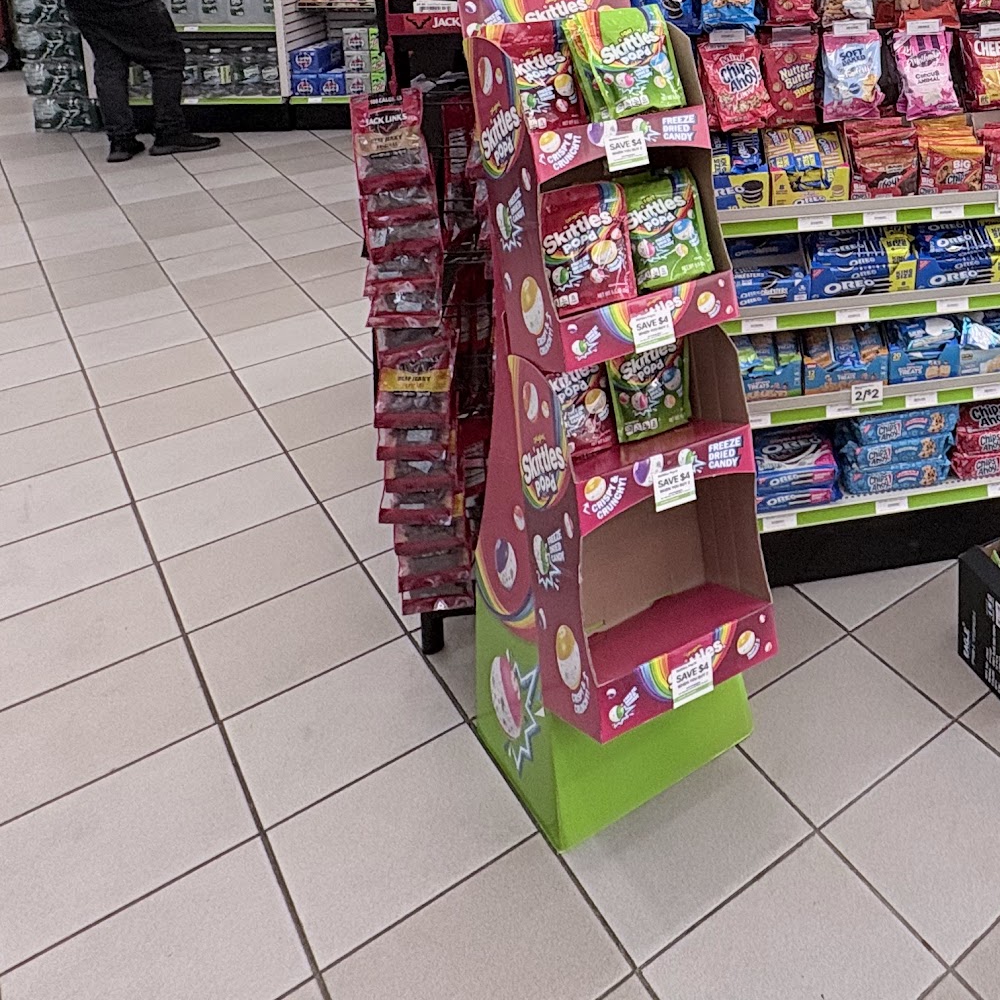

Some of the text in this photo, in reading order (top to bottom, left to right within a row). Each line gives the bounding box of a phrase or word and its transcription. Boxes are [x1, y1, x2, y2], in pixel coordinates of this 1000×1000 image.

[432, 16, 461, 28] JACK
[601, 30, 660, 65] Skittles
[839, 49, 866, 60] SOFT
[721, 53, 744, 64] Mini
[720, 61, 755, 82] Chips
[778, 62, 812, 78] Nutter
[784, 70, 815, 85] Butter
[662, 114, 695, 125] FREEZE
[480, 105, 523, 161] Skittles
[662, 123, 690, 134] DRIED
[662, 131, 694, 142] CANDY
[547, 137, 570, 165] CRISPY
[552, 134, 582, 171] CRUNCHY!
[610, 141, 631, 151] SAVE
[631, 139, 642, 147] $4
[716, 187, 744, 197] REO
[627, 194, 688, 230] Skittles
[543, 210, 614, 255] Skittles
[929, 270, 978, 288] OREO
[824, 278, 876, 296] OREO
[636, 319, 657, 331] SAVE
[658, 316, 669, 325] $4
[854, 387, 880, 400] 2/$2
[878, 423, 898, 437] Chips
[708, 436, 742, 451] FREEZE
[763, 437, 821, 455] OREO
[979, 434, 1000, 446] Chips
[708, 448, 735, 462] DRIED
[522, 443, 567, 484] Skittles
[708, 456, 739, 470] CANDY
[657, 475, 679, 489] SAVE
[679, 471, 691, 482] $4
[770, 473, 799, 487] OREO
[592, 484, 618, 514] CRISPY
[596, 475, 628, 521] CRUNCHY!
[766, 494, 796, 507] OREO
[675, 663, 710, 684] SAVE $4
